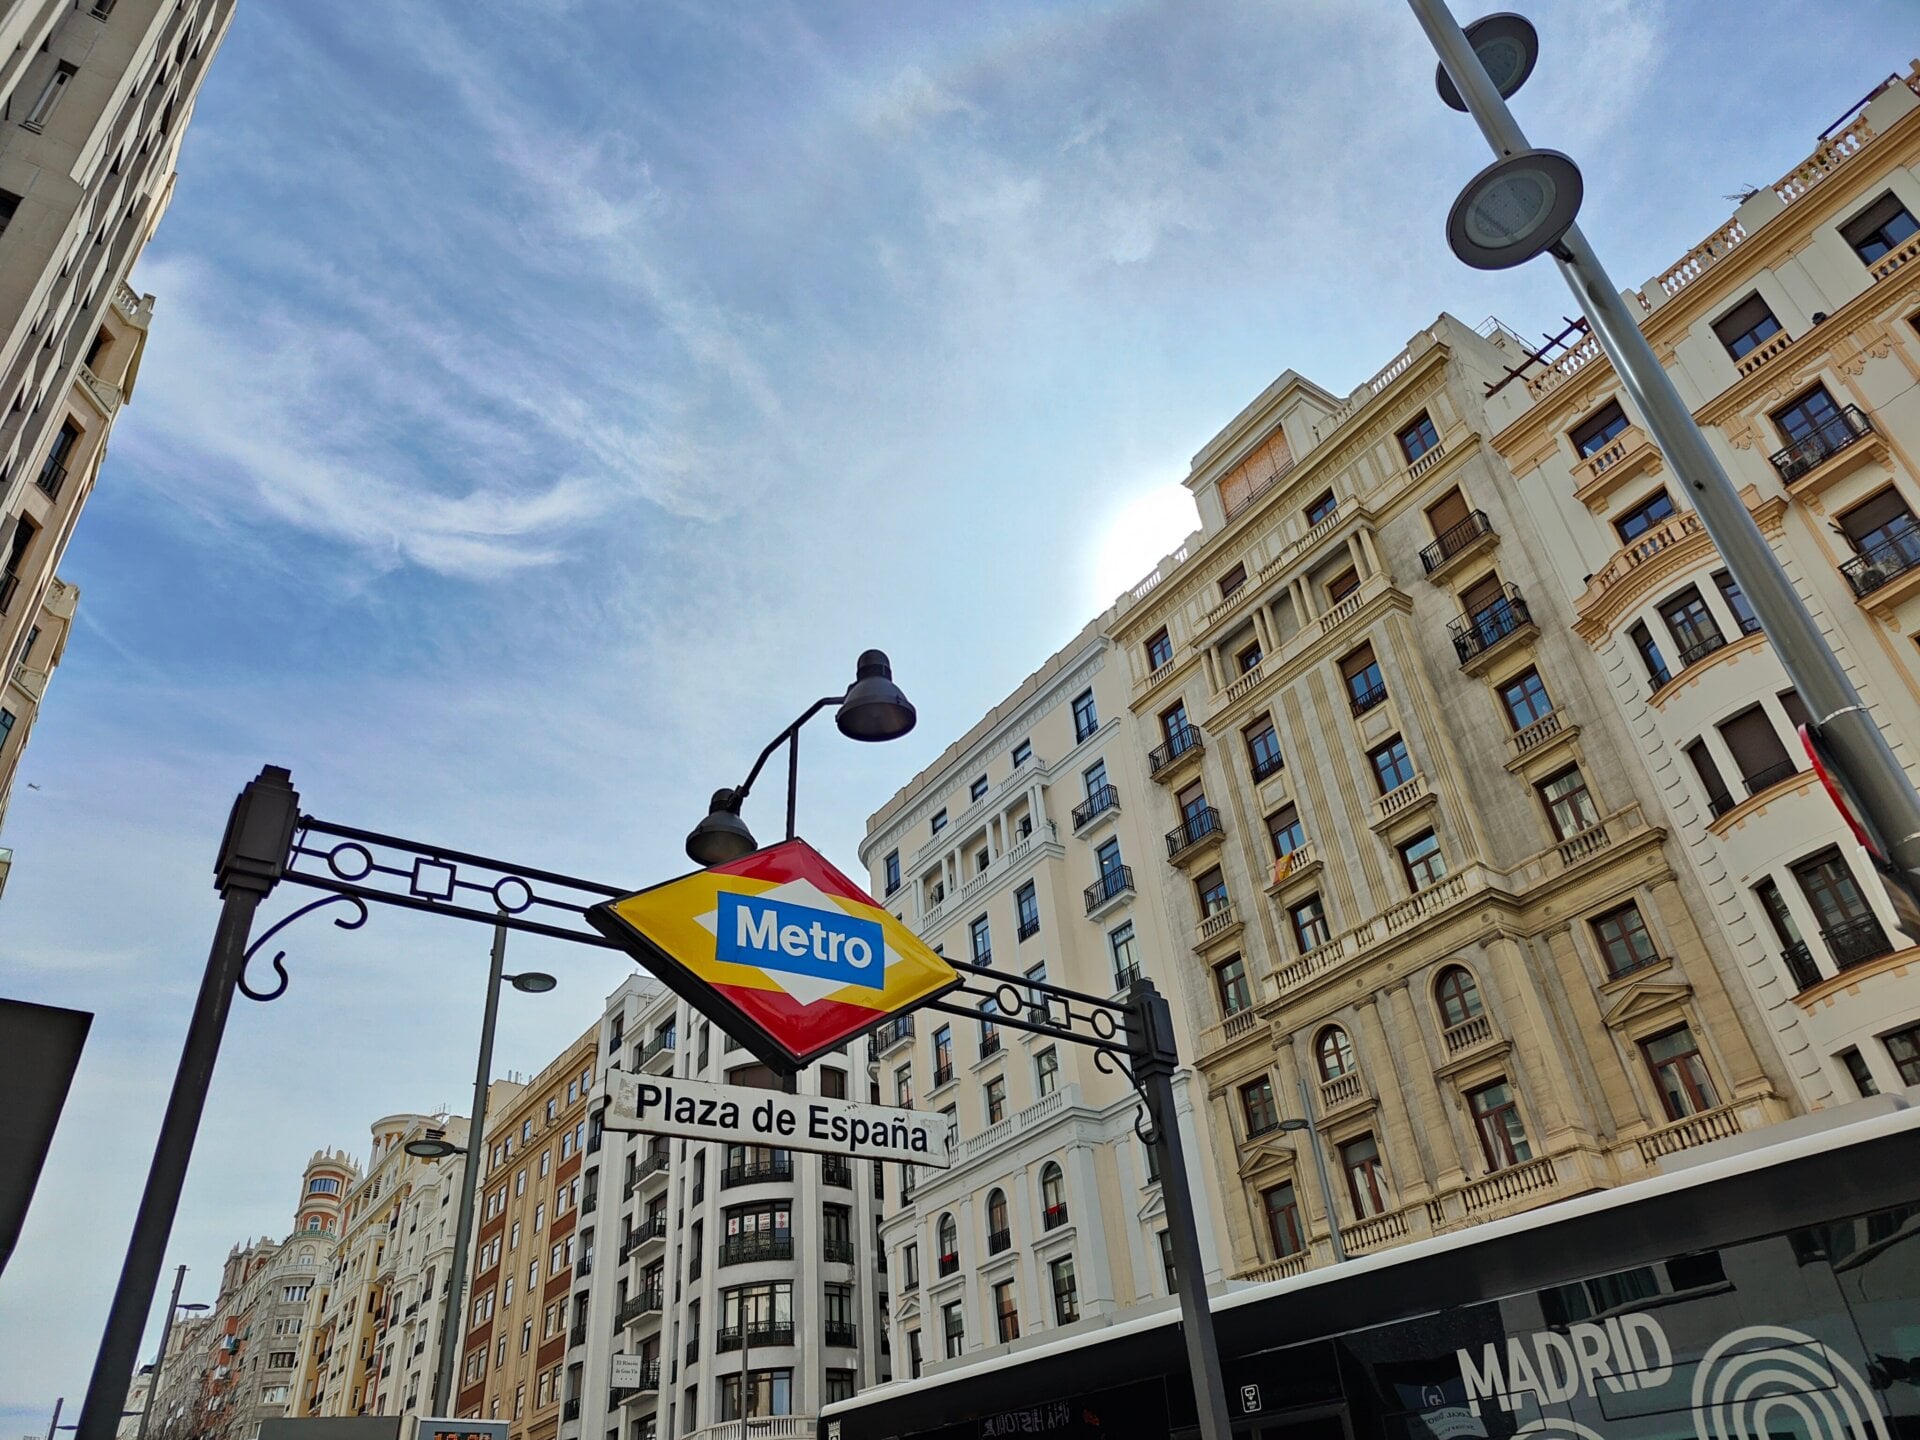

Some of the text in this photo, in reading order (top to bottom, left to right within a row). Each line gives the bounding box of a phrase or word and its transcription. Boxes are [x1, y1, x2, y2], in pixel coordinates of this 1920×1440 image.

[737, 905, 872, 968] Metro
[636, 1084, 928, 1152] Plaza de España
[1456, 1312, 1673, 1417] MADRID
